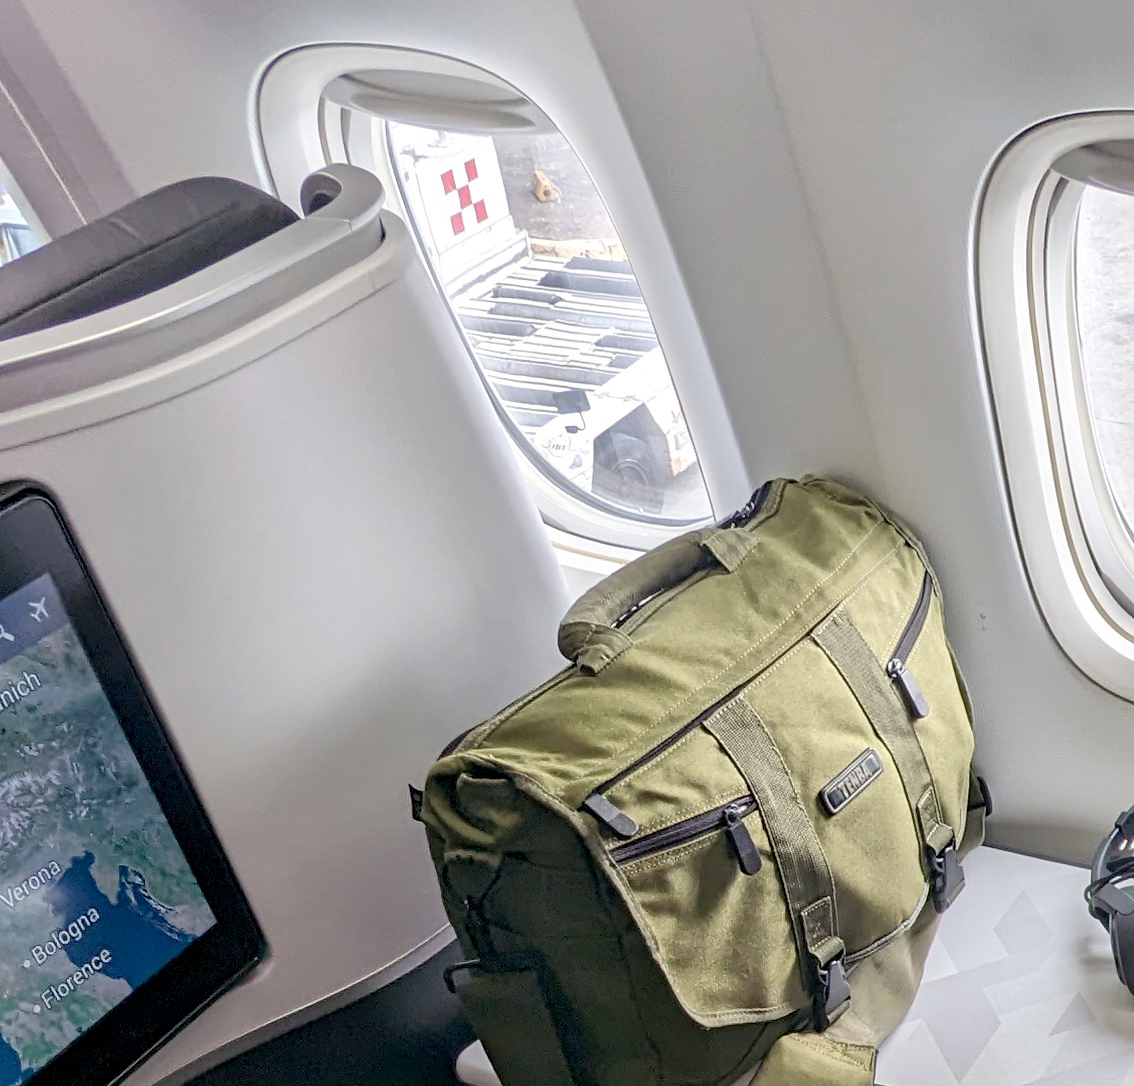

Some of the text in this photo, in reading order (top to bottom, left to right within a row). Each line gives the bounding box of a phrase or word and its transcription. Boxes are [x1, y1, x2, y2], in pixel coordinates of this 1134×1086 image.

[0, 671, 42, 711] nich
[0, 861, 61, 907] Verona
[31, 908, 100, 965] Bologna
[40, 948, 112, 1010] Florence
